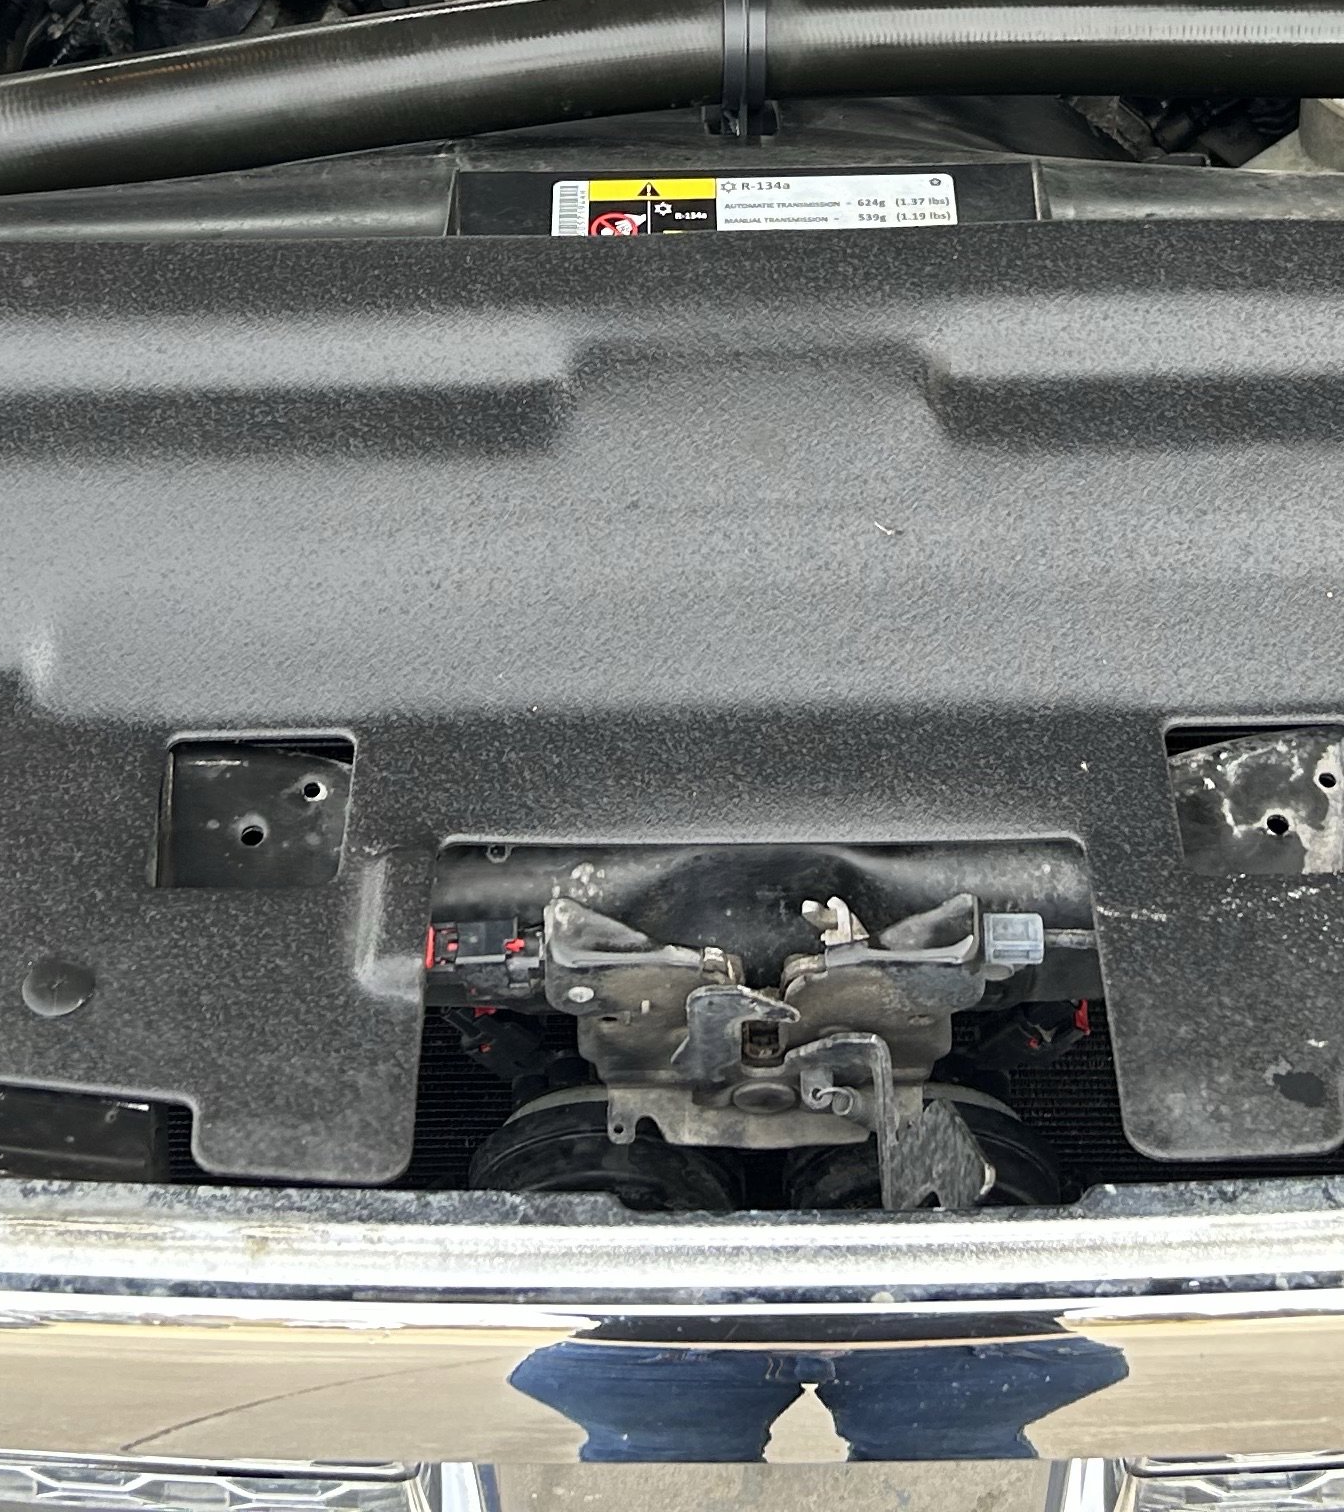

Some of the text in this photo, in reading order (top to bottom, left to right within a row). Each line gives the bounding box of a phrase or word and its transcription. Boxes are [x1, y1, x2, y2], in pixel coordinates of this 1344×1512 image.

[741, 181, 791, 191] R-134a
[857, 198, 886, 208] 624g
[895, 198, 925, 207] (1.37
[929, 197, 950, 207] lbs)
[674, 211, 708, 220] R-134a
[858, 213, 887, 222] 539g
[896, 212, 926, 222] (1.19
[930, 211, 951, 220] lbs)
